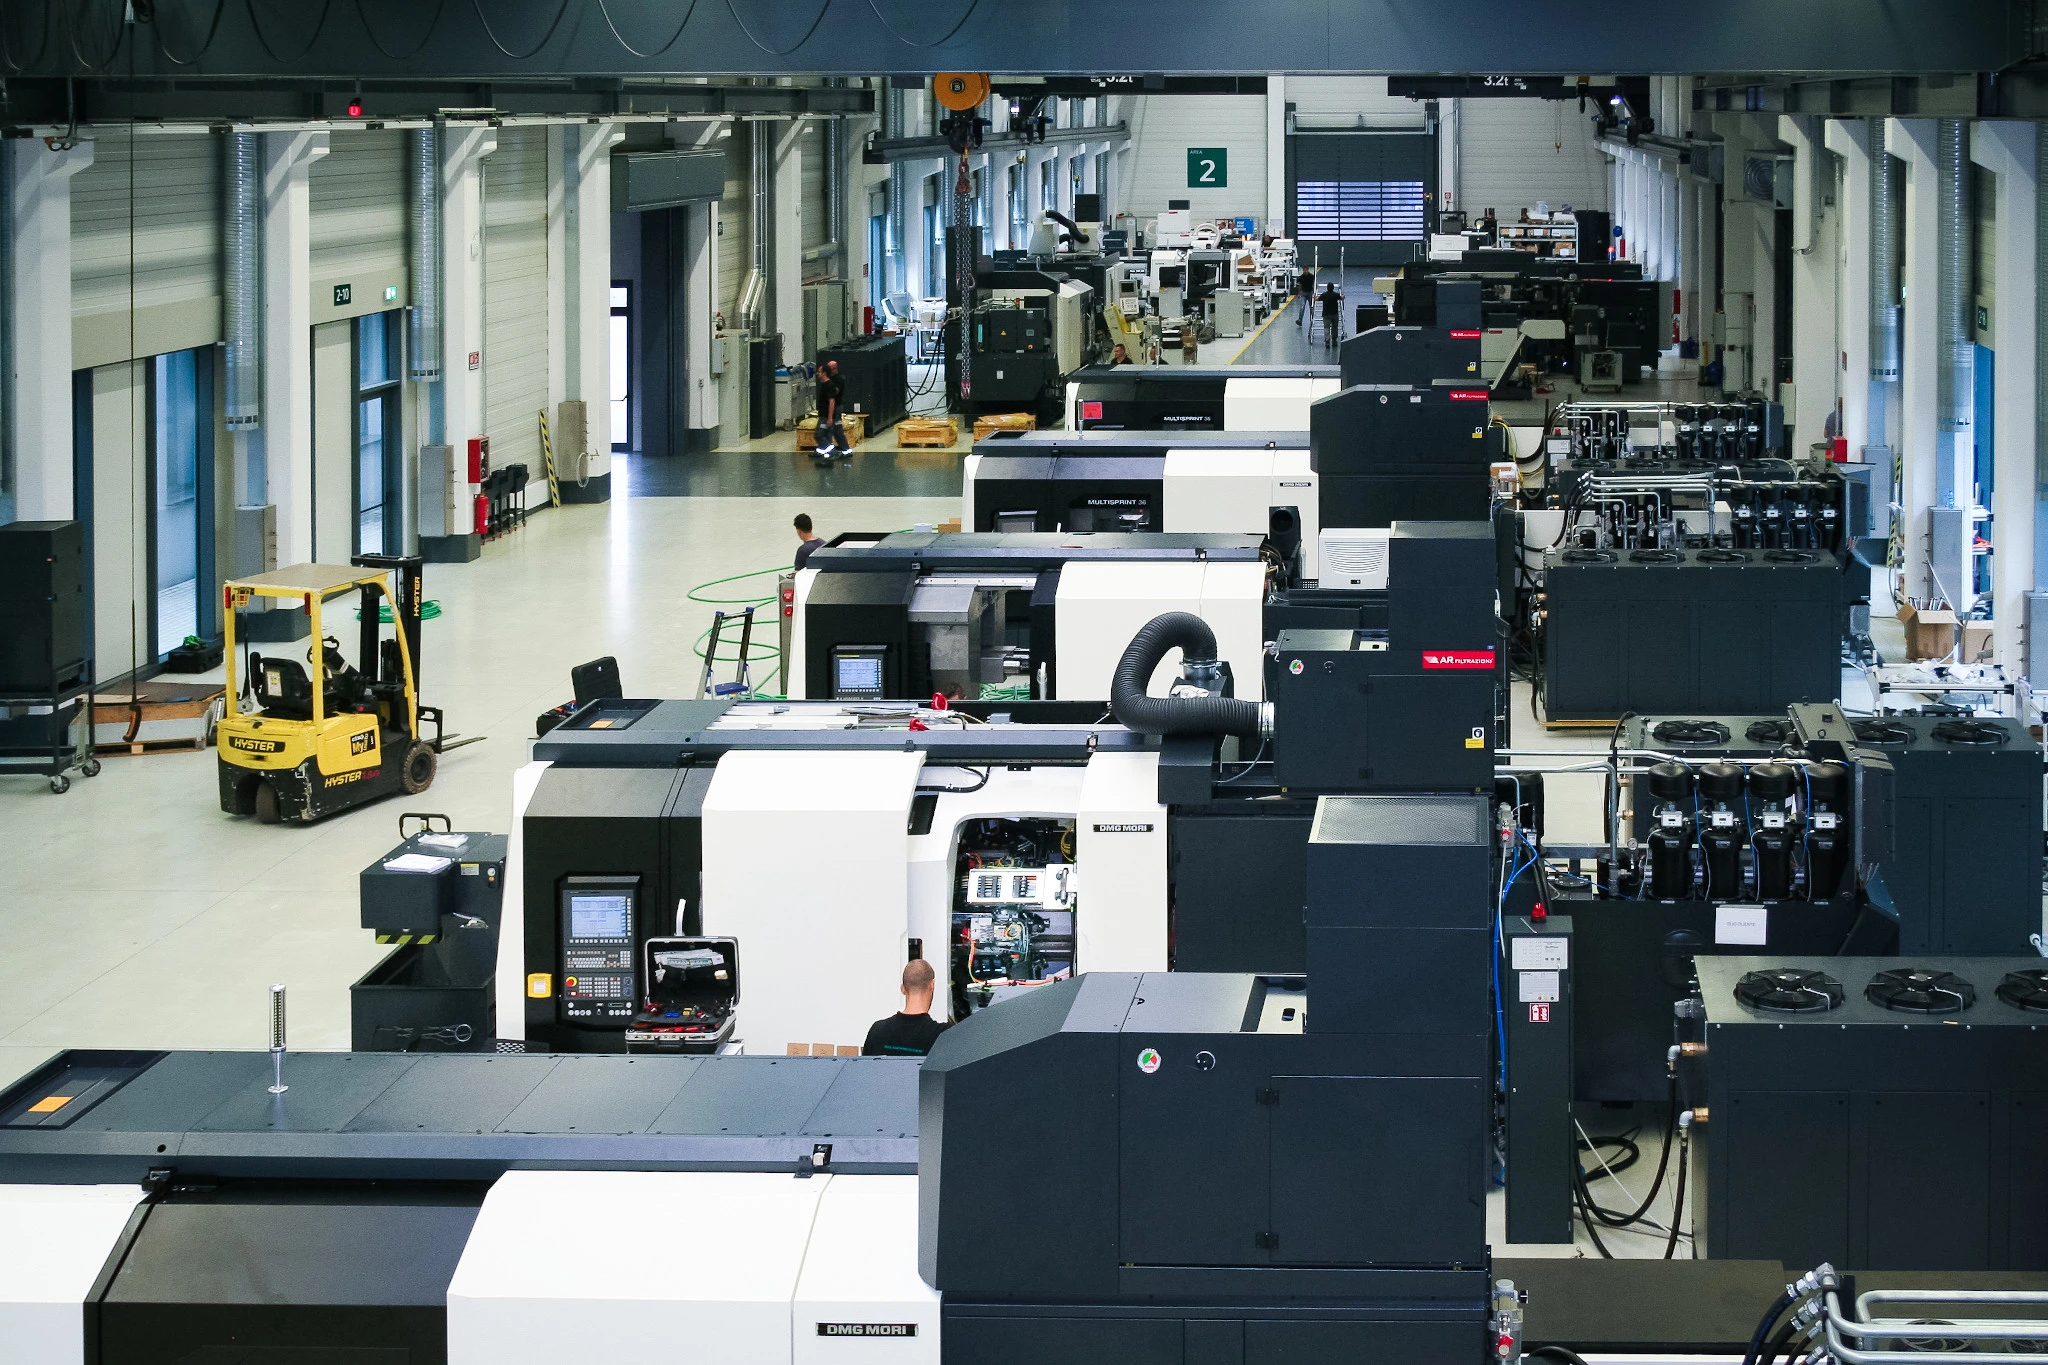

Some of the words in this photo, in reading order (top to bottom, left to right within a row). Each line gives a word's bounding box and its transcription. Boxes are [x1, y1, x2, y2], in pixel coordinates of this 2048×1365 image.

[1484, 75, 1508, 86] 3.2t
[1200, 159, 1215, 181] 2
[336, 288, 350, 302] 2-10
[413, 576, 421, 617] HYSTER
[1439, 656, 1454, 664] AR
[234, 737, 276, 752] HYSTER
[324, 771, 362, 788] HYSTER
[826, 1324, 864, 1335] DMG
[865, 1324, 907, 1335] MORI
